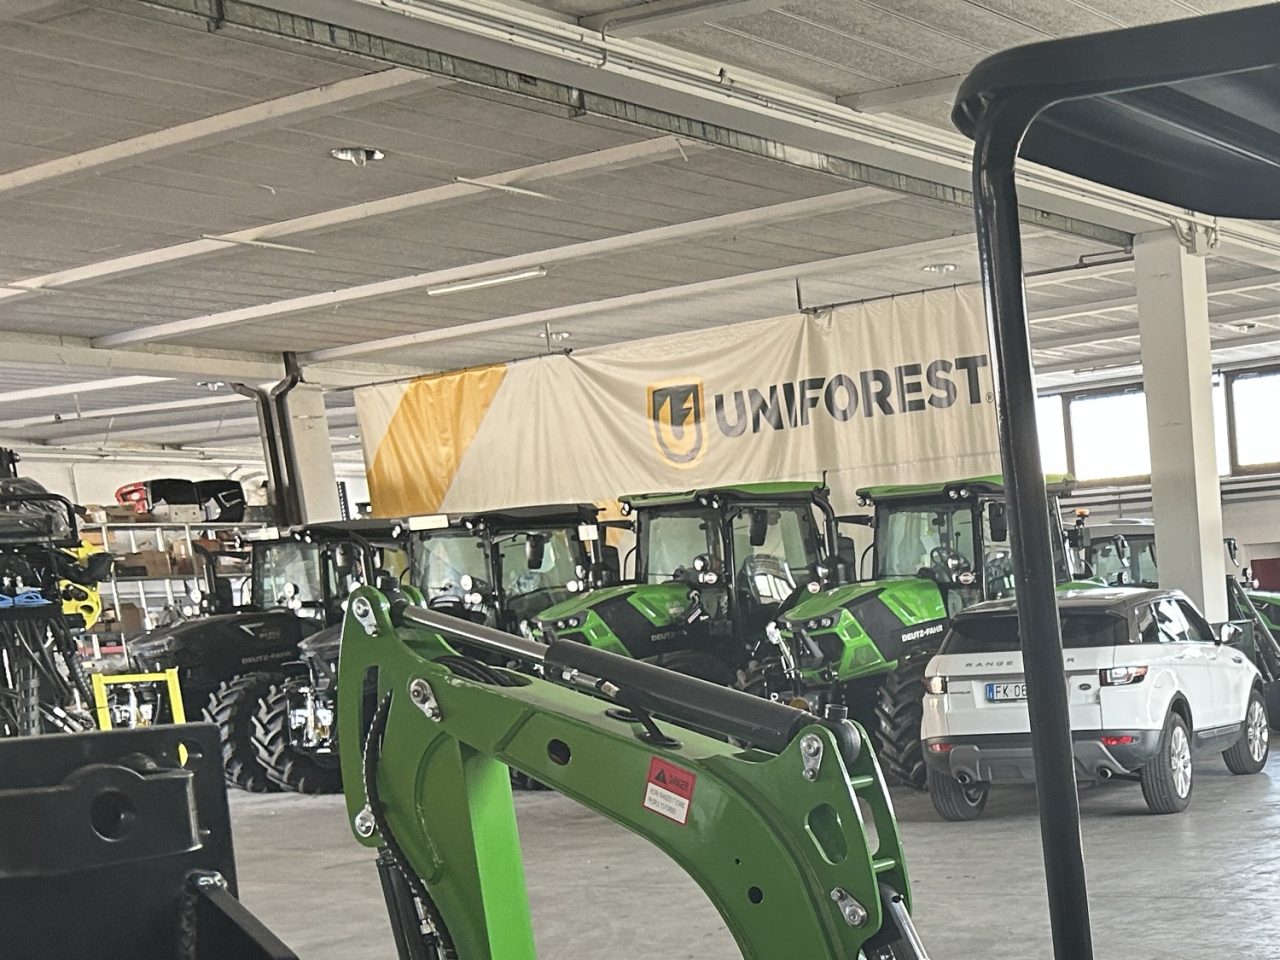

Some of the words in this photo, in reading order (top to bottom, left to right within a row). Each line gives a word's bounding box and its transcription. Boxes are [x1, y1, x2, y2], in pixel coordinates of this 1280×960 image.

[714, 354, 988, 438] UNIFOREST
[902, 624, 944, 642] DEUTZ-FAHR
[965, 660, 1014, 669] RANGE
[1014, 684, 1027, 697] 06
